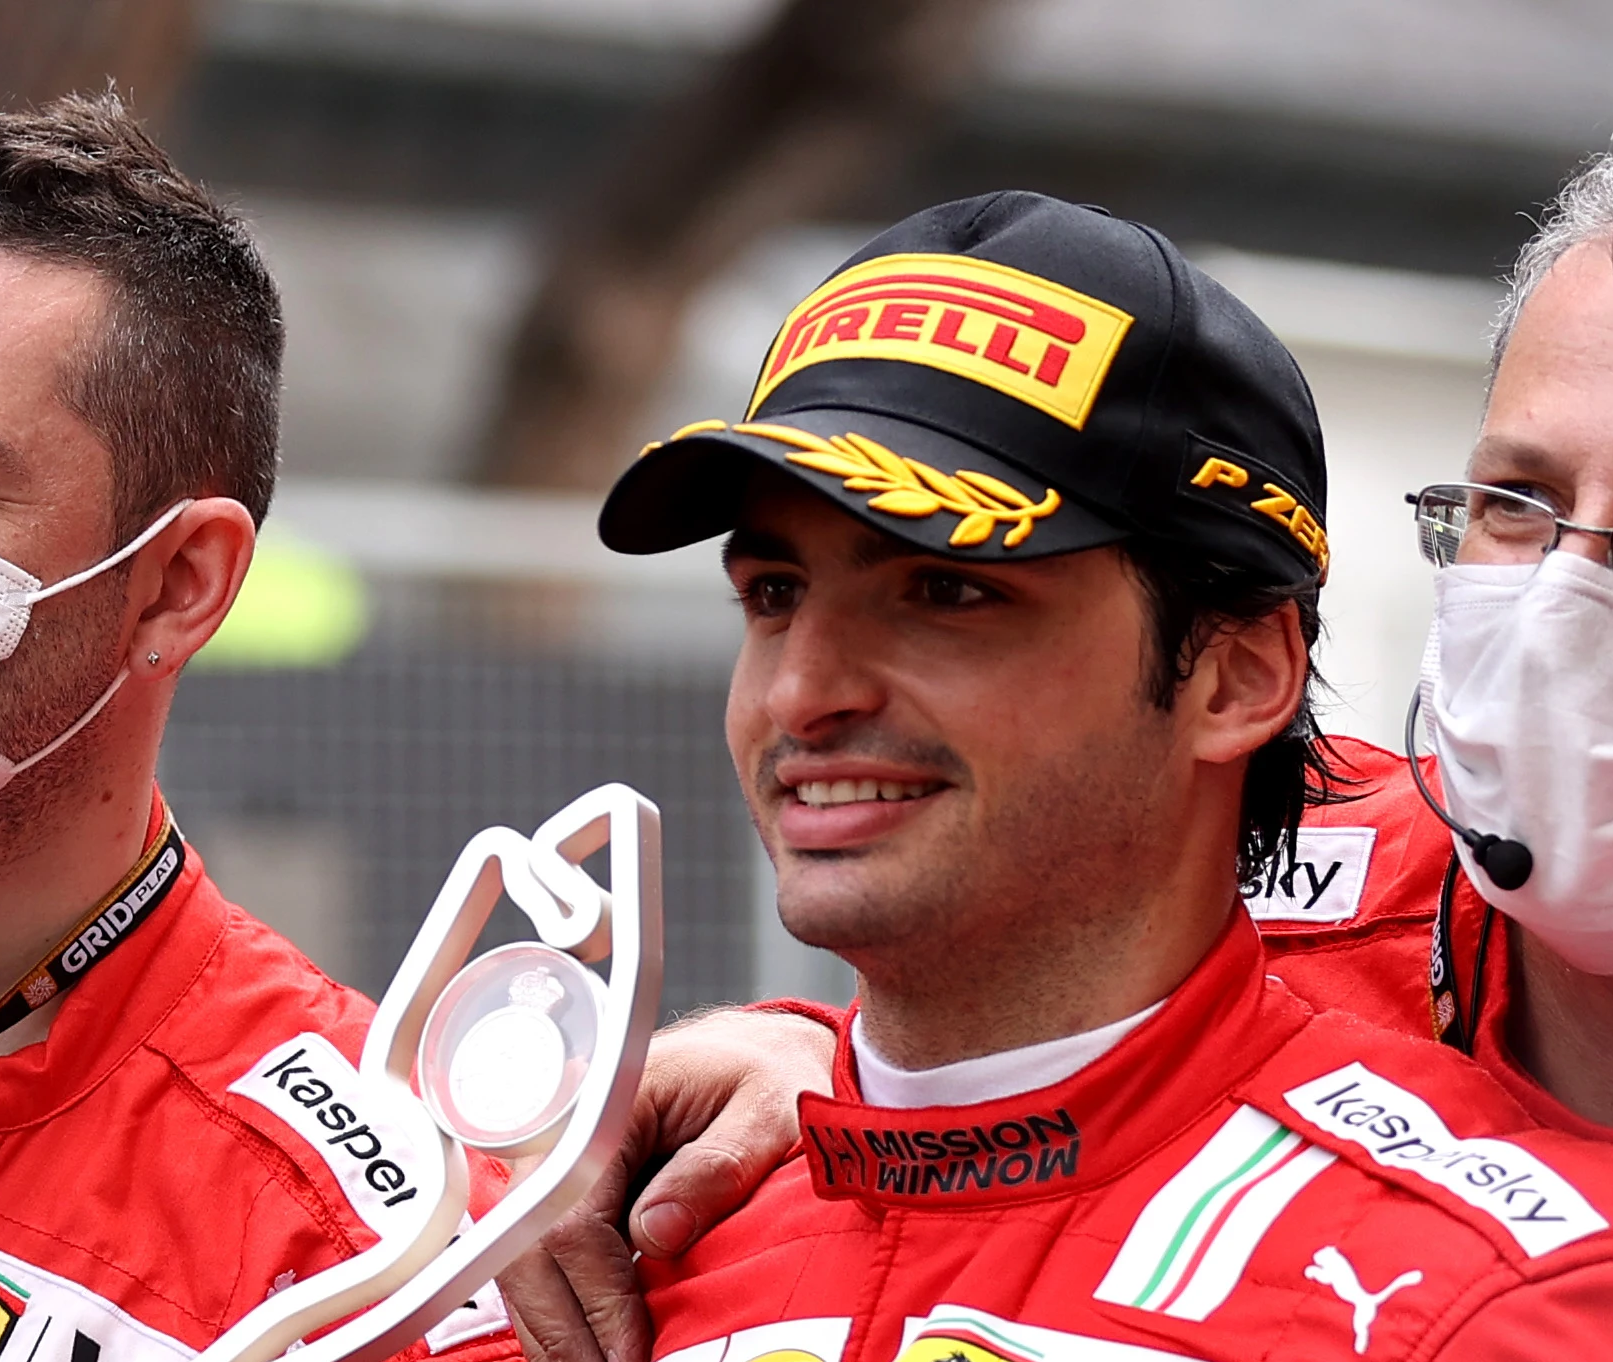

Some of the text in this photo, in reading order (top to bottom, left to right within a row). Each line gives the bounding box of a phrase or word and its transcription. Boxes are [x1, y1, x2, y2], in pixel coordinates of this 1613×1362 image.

[765, 274, 1086, 386] PIRELLI
[1190, 457, 1248, 488] P
[61, 902, 134, 974] GRID
[861, 1107, 1079, 1161] MISSION
[1314, 1081, 1568, 1222] kaspersky
[875, 1139, 1080, 1195] WINNOW
